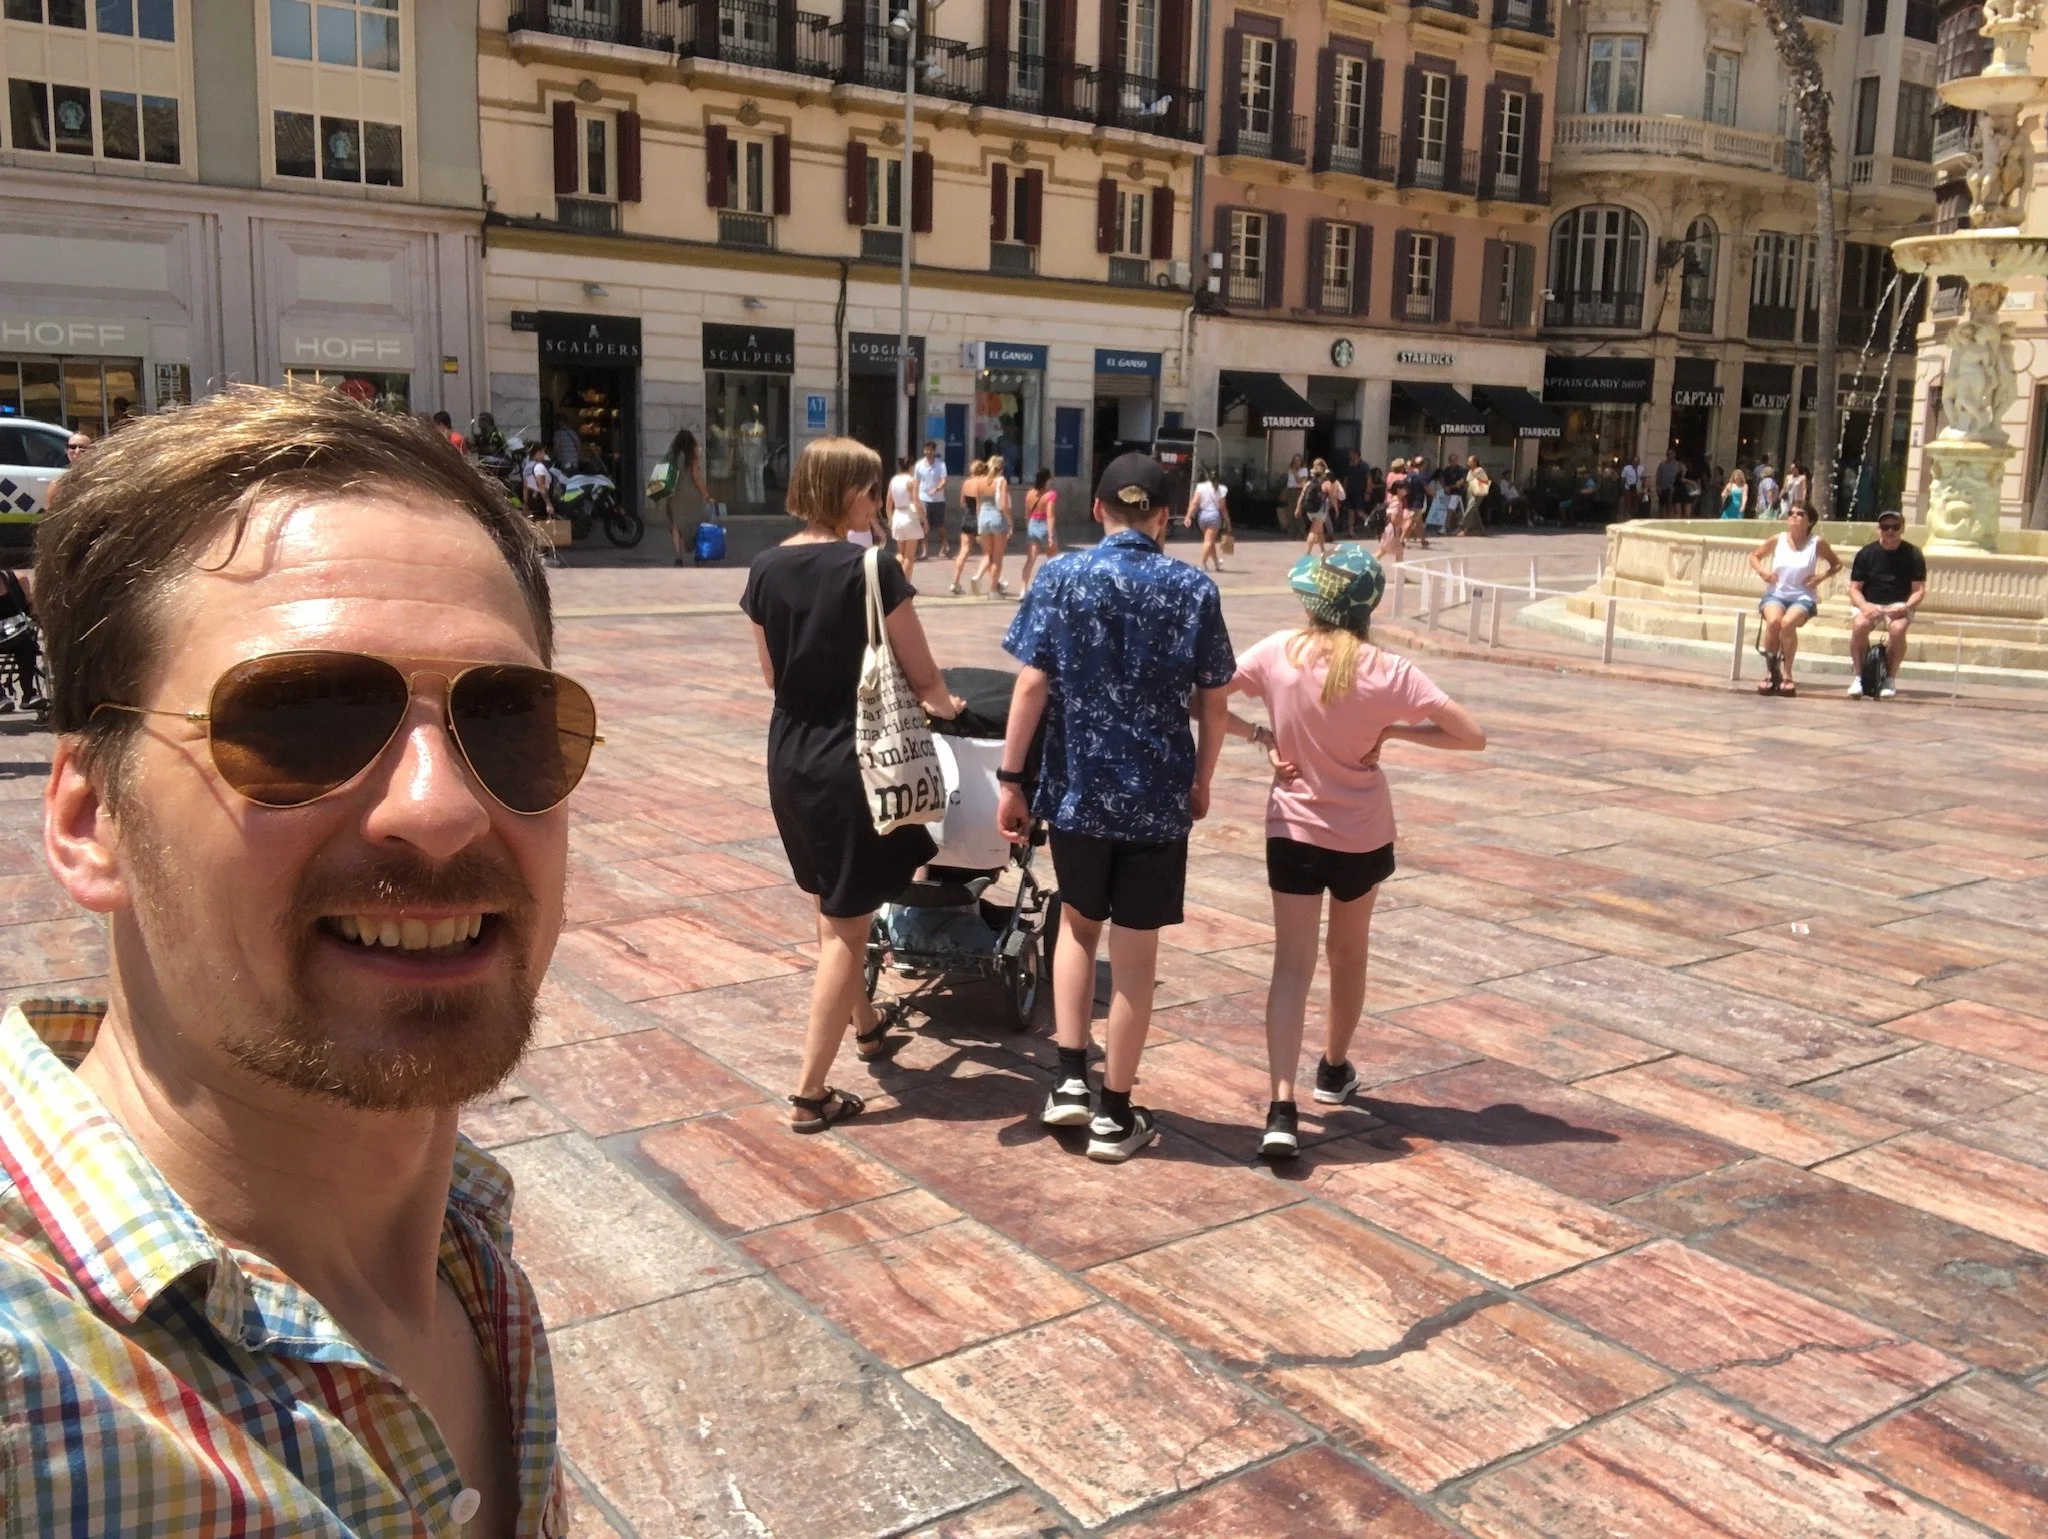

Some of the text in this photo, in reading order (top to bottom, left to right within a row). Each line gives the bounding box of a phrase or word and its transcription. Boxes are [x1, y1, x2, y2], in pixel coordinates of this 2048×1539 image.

[1, 320, 126, 348] HOFF
[294, 335, 401, 361] HOFF
[545, 339, 639, 357] SCALPERS
[709, 348, 793, 365] SCALPERS
[989, 350, 1034, 362] EL GANSO
[1399, 351, 1457, 366] STARBUCKS
[1106, 358, 1148, 369] EL GANSO
[1544, 376, 1647, 390] APTAIN CANDY SHOP
[808, 398, 825, 412] AT
[1674, 389, 1726, 407] CAPTAIN
[1752, 392, 1792, 410] CANDY
[1262, 415, 1315, 428] STARBUCKS
[1439, 423, 1486, 435] STARBUCKS
[1518, 426, 1561, 437] STARBUCKS
